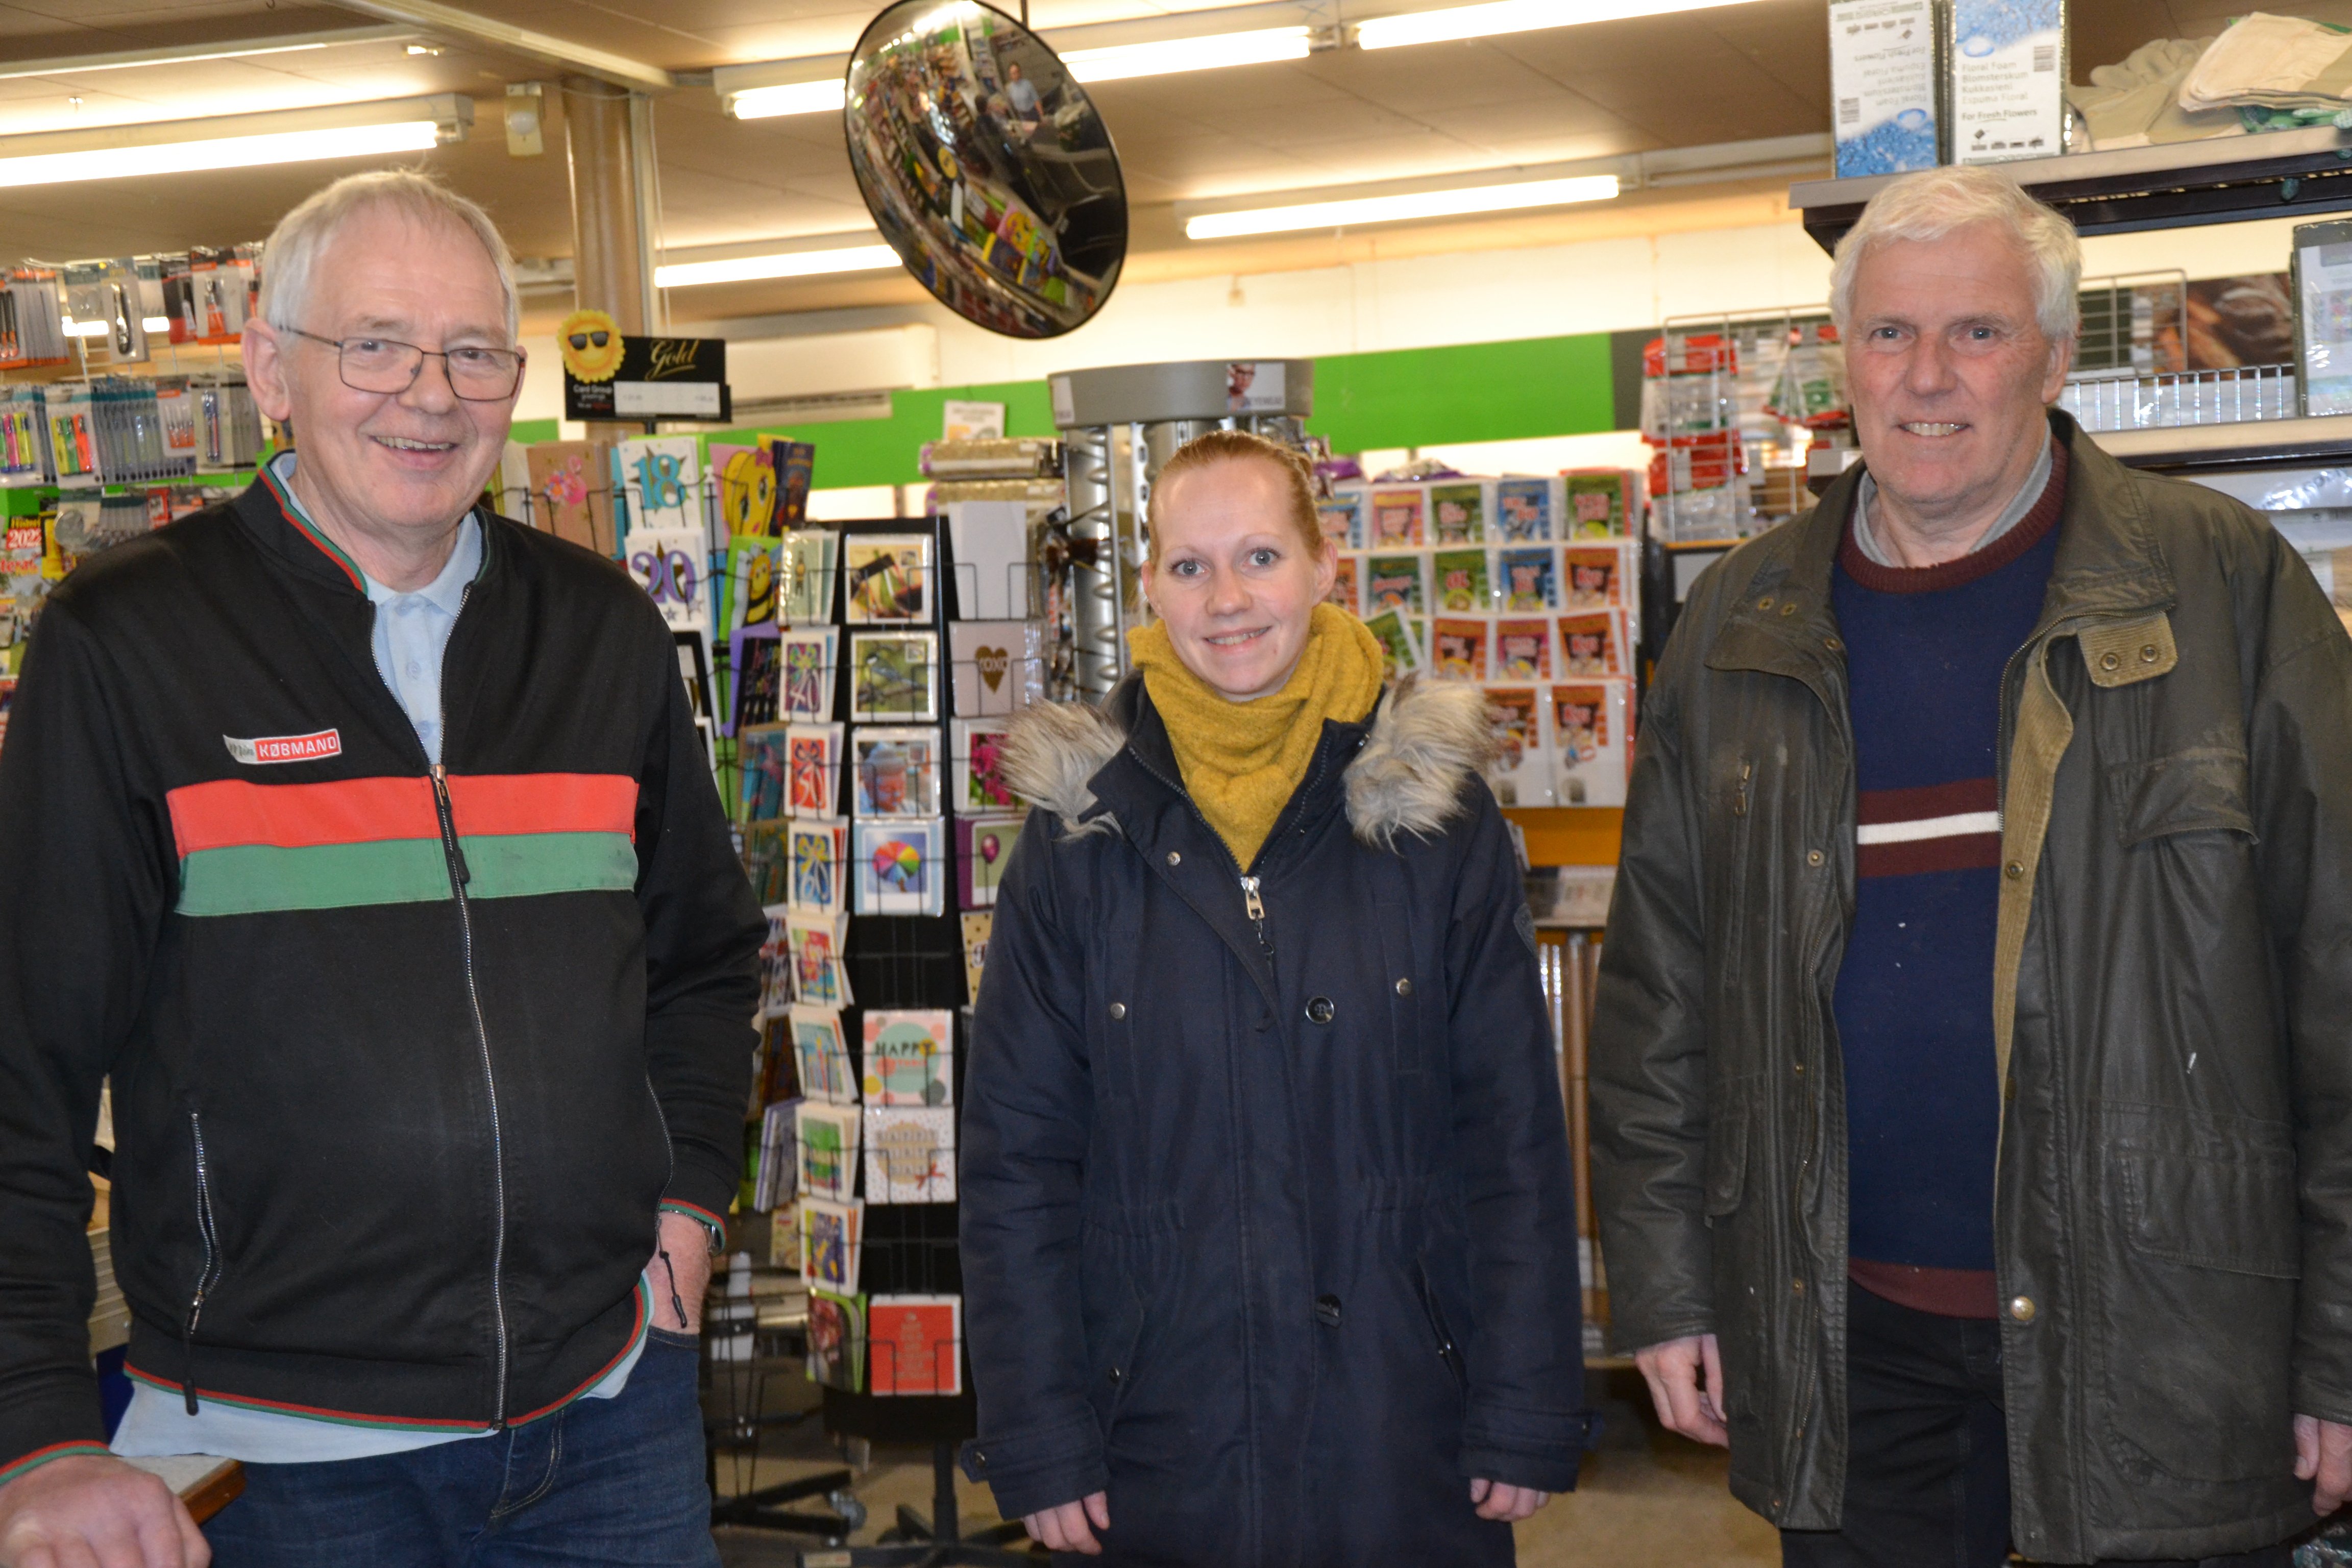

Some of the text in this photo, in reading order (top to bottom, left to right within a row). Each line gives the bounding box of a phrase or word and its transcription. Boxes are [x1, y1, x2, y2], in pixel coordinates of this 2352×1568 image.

[1978, 111, 2001, 119] Fresh
[2004, 109, 2038, 117] Flowers
[645, 333, 700, 381] Gold
[631, 453, 687, 510] 18
[631, 549, 698, 604] 20
[259, 736, 337, 757] KØBMAND
[875, 1041, 933, 1056] HAPPY
